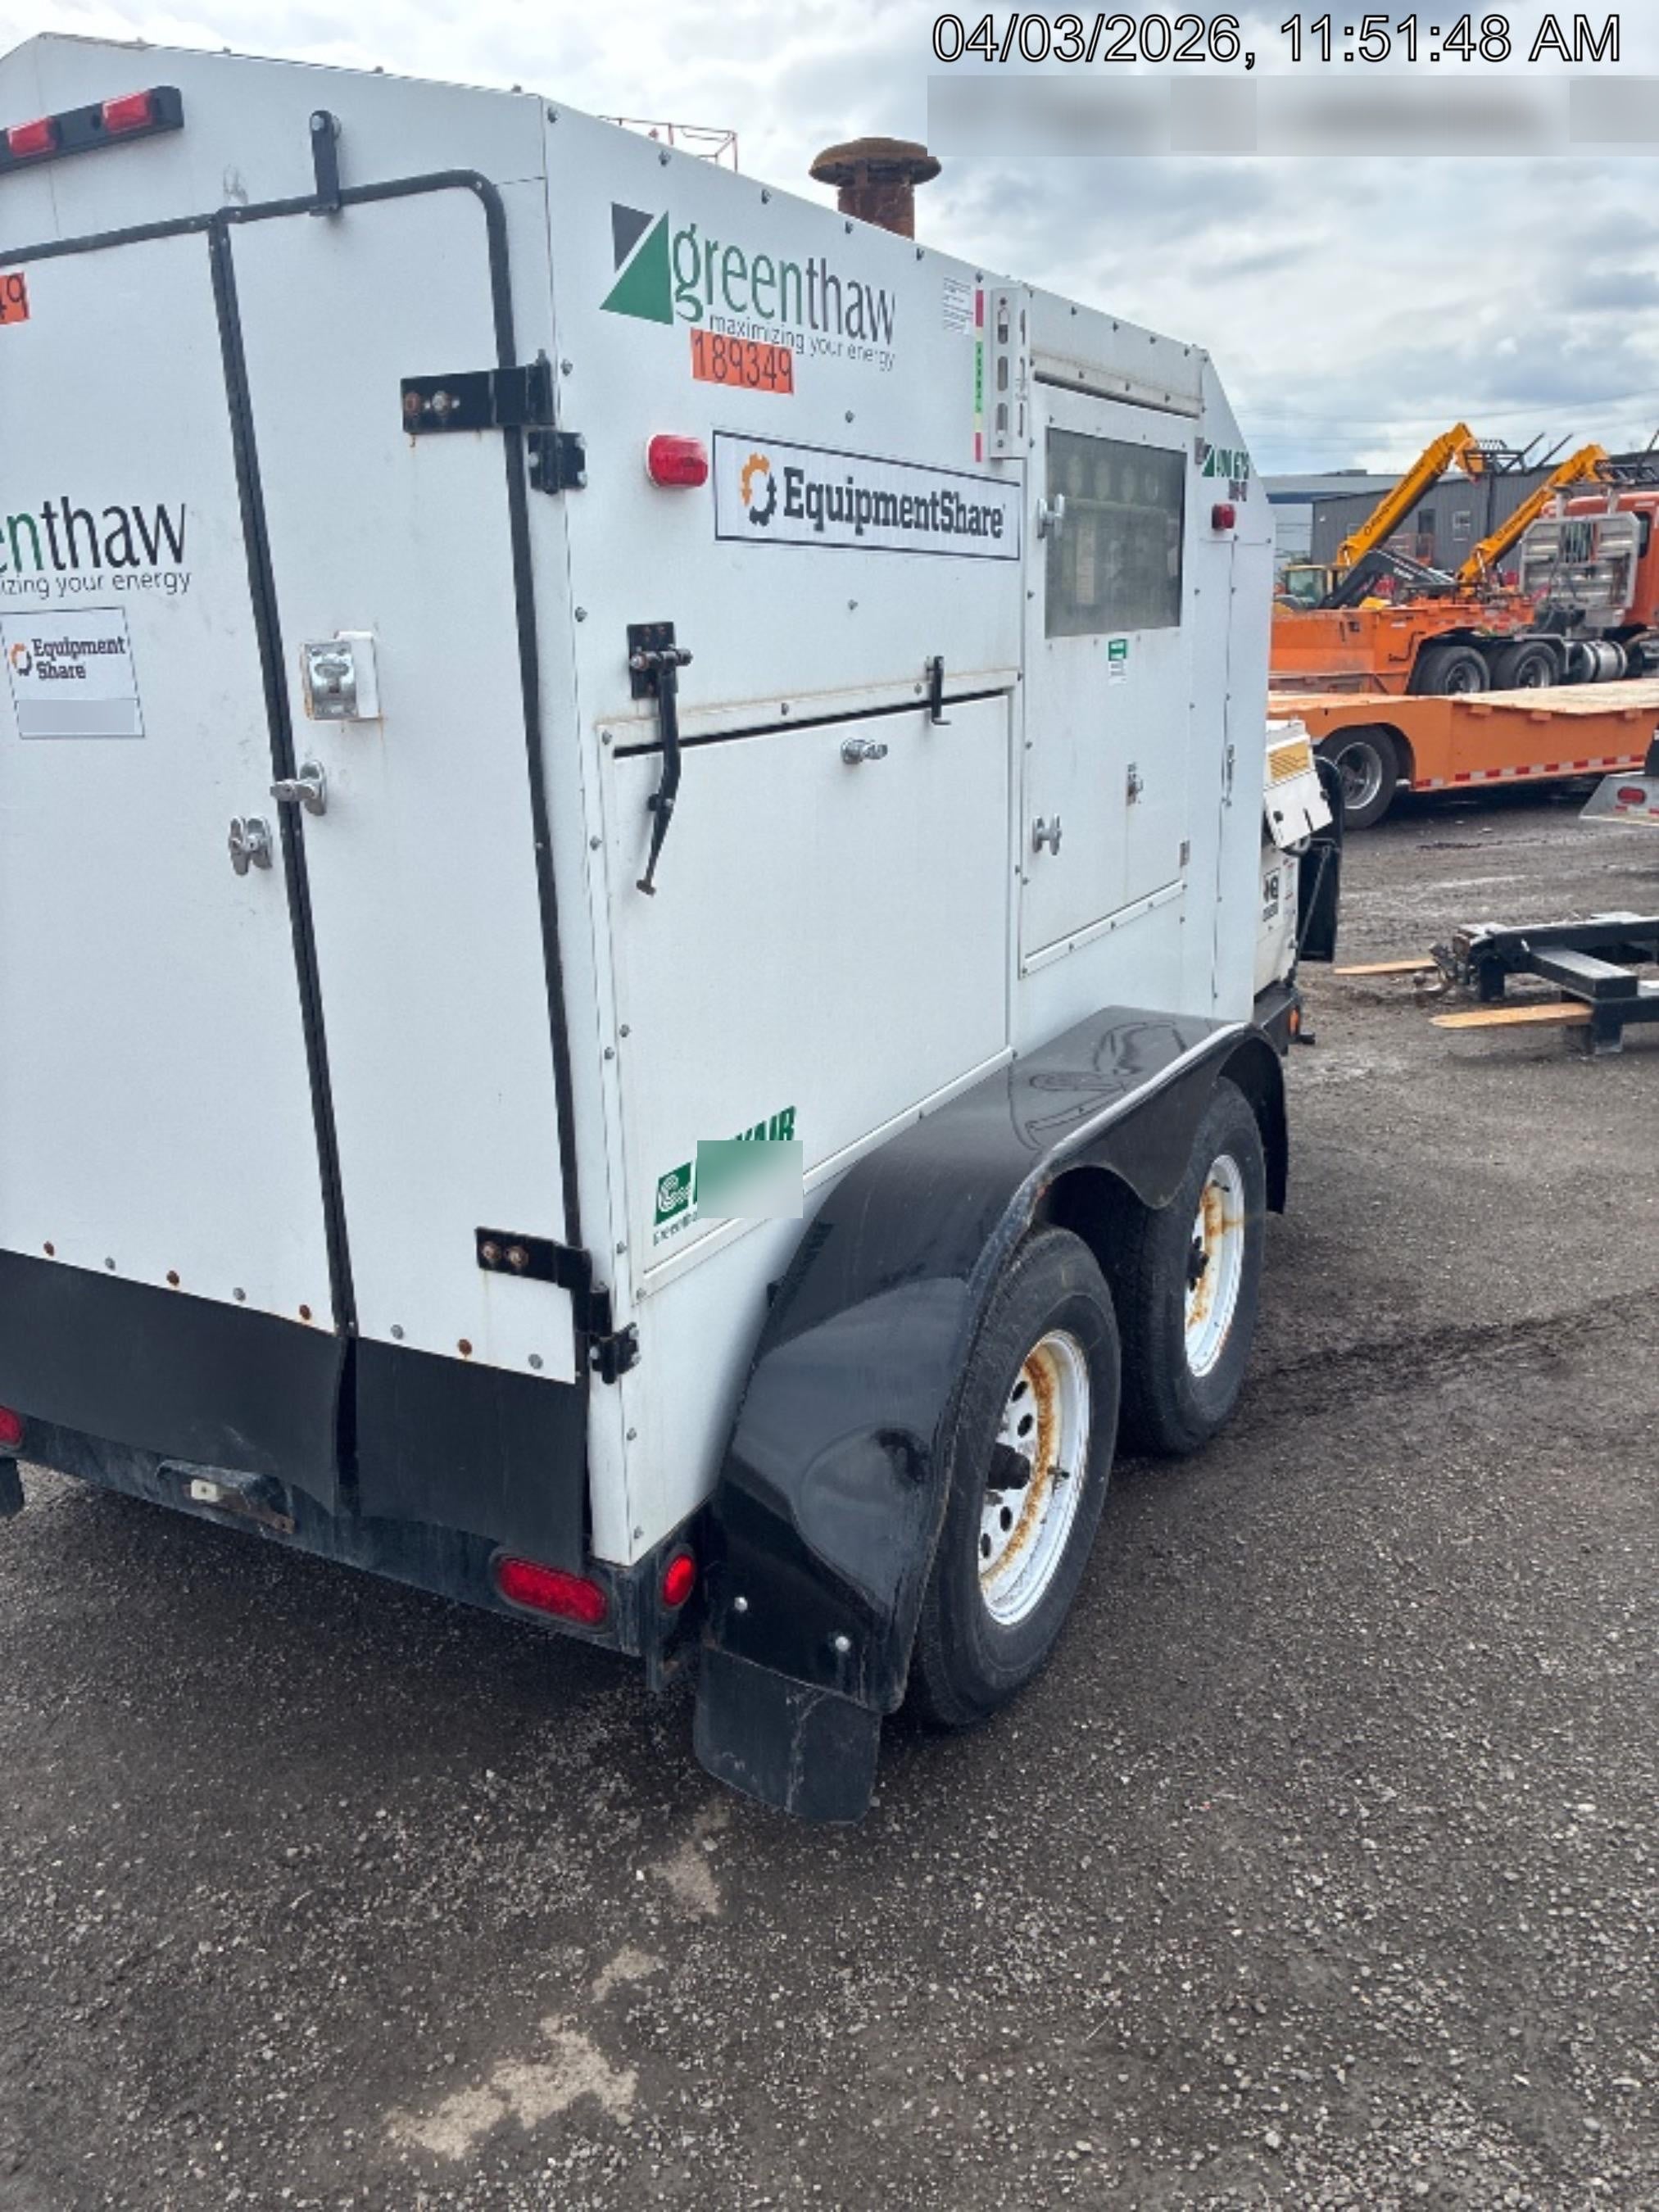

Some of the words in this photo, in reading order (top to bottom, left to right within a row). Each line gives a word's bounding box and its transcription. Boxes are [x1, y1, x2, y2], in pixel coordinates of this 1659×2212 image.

[673, 222, 896, 346] greenthaw
[691, 330, 794, 392] 189349
[709, 313, 805, 354] maximizing
[809, 336, 845, 357] your
[847, 342, 896, 372] energy
[783, 466, 1004, 539] EquipmentShare
[0, 496, 186, 573] nthaw
[56, 574, 103, 597] your
[112, 572, 192, 596] energy
[31, 636, 126, 661] Equipment
[36, 660, 87, 680] Share
